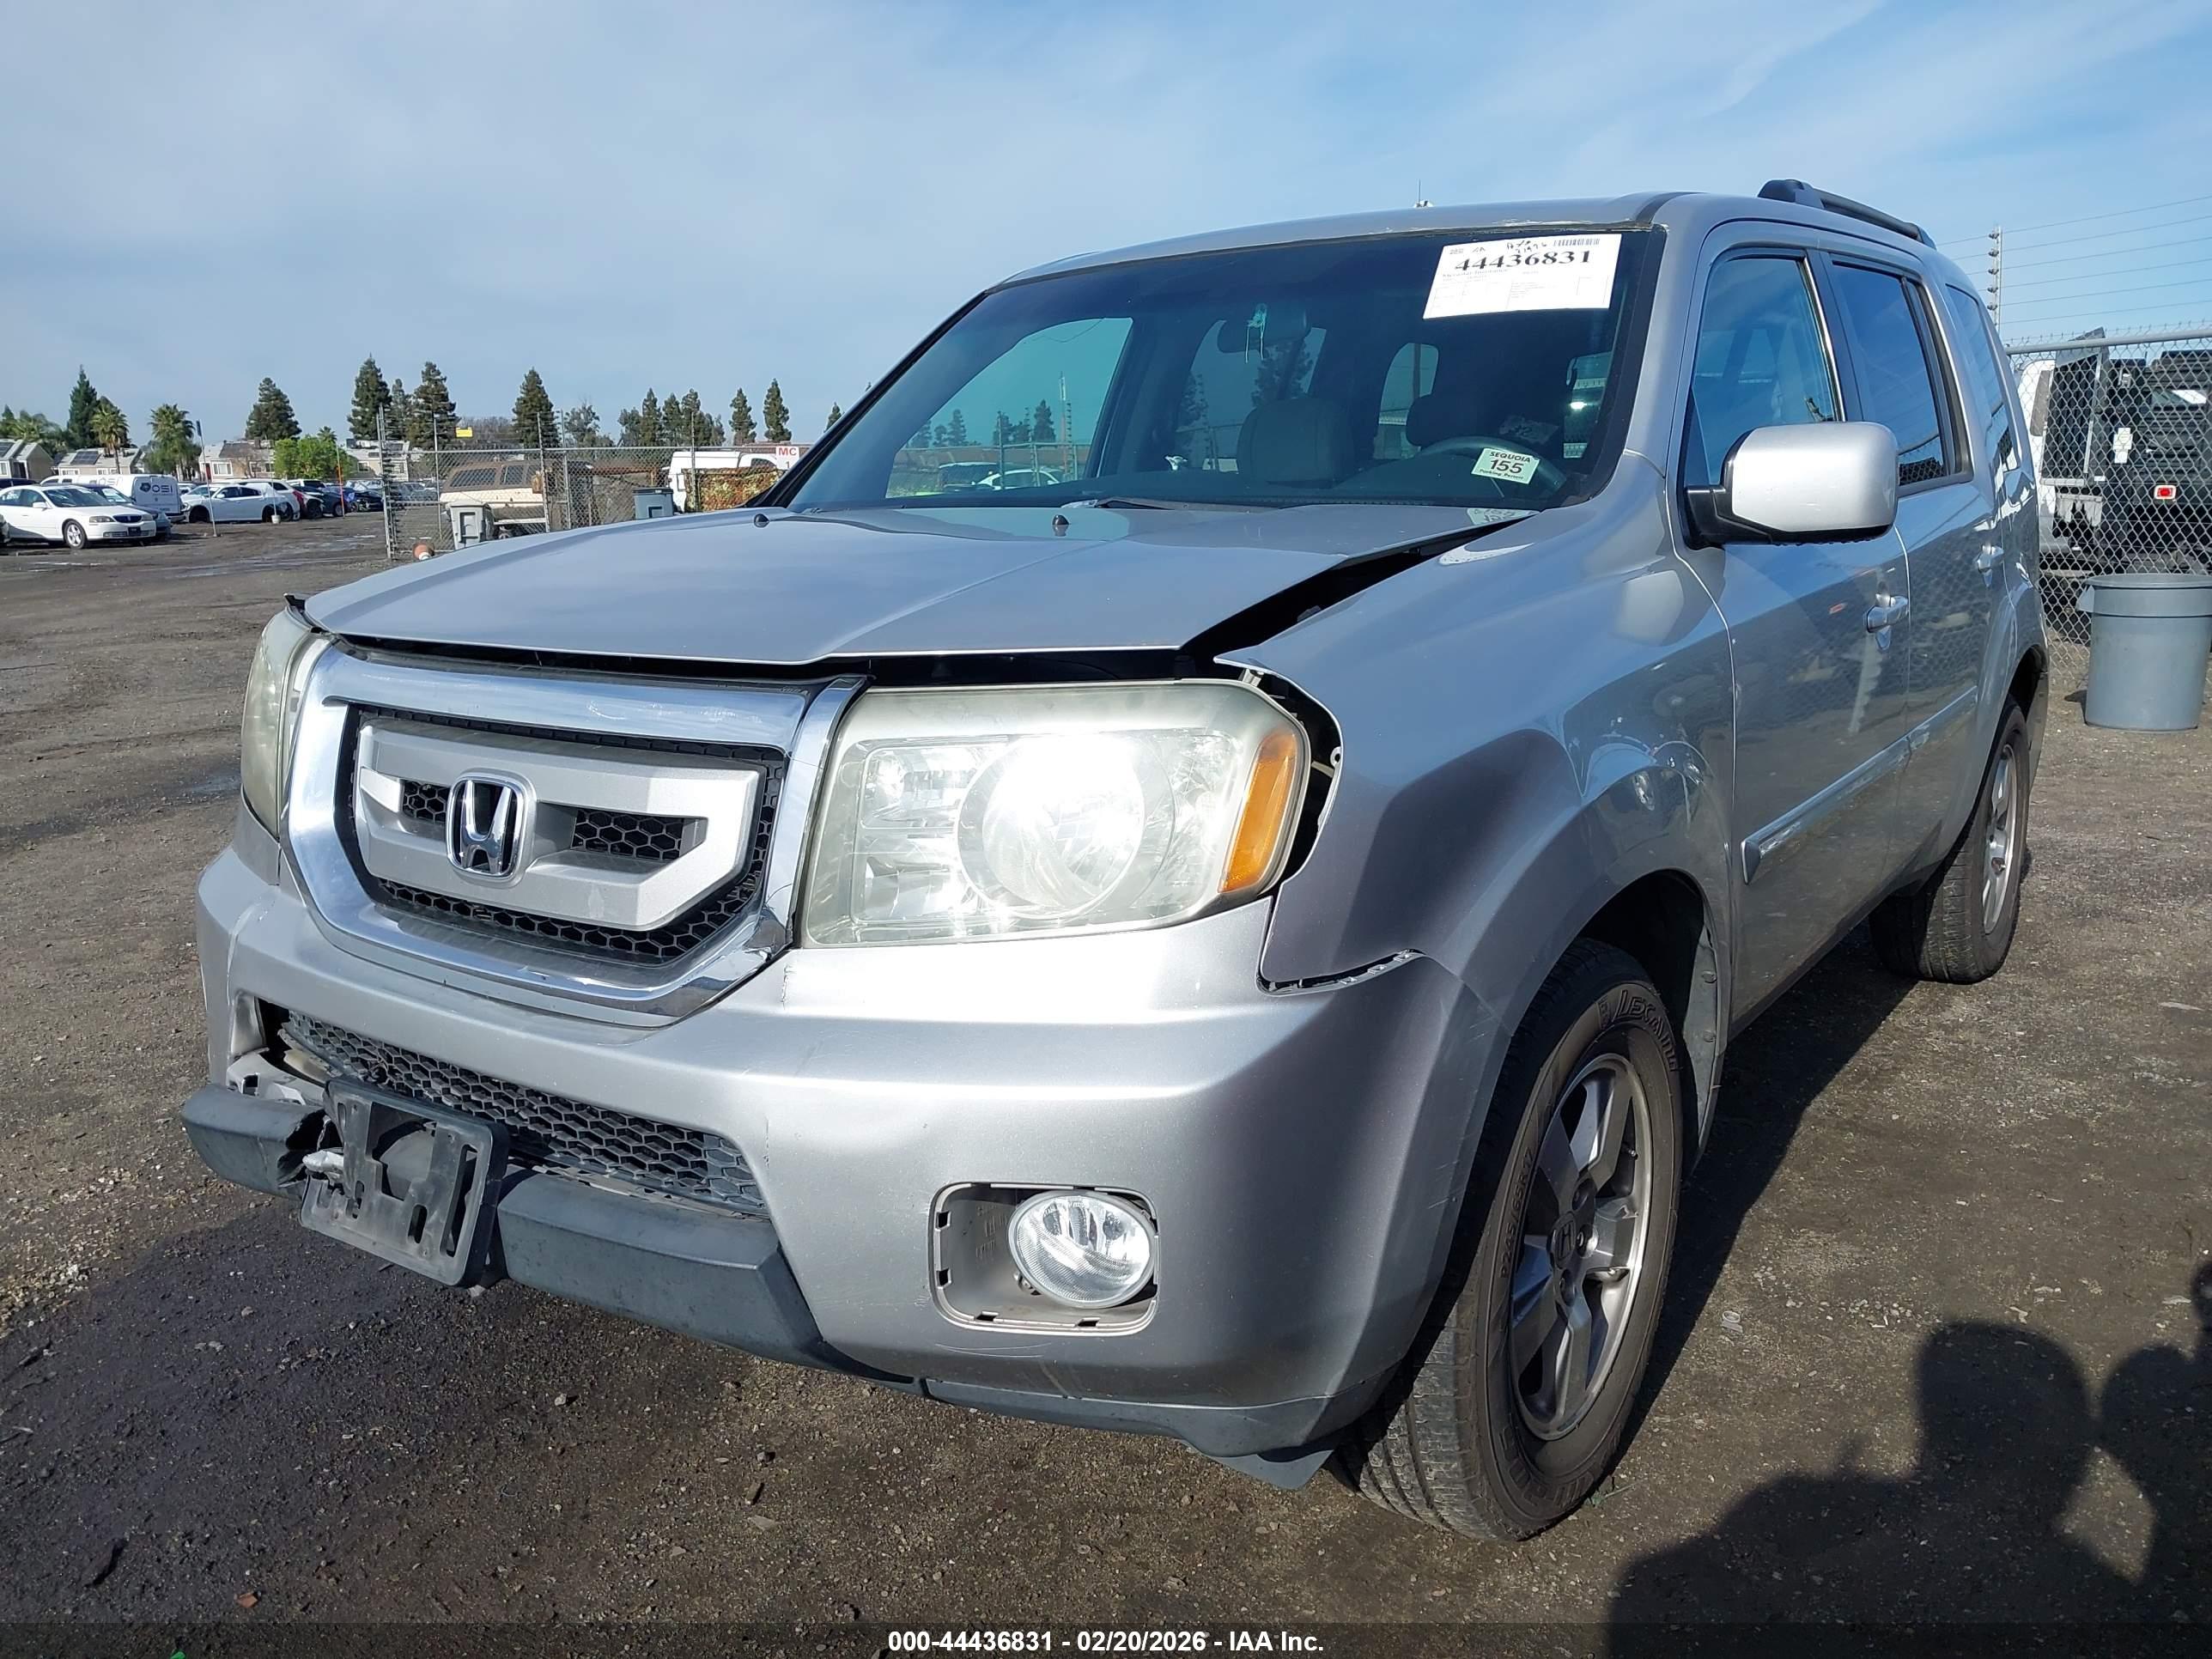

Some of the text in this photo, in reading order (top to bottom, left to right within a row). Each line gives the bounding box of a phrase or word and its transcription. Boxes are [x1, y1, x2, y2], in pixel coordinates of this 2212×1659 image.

[1455, 250, 1590, 271] 44436831
[778, 447, 797, 456] MC
[1490, 451, 1530, 463] SEQUOIA
[1490, 459, 1524, 474] 155
[151, 484, 173, 493] OSI
[1498, 1146, 1534, 1278] P245/65R17
